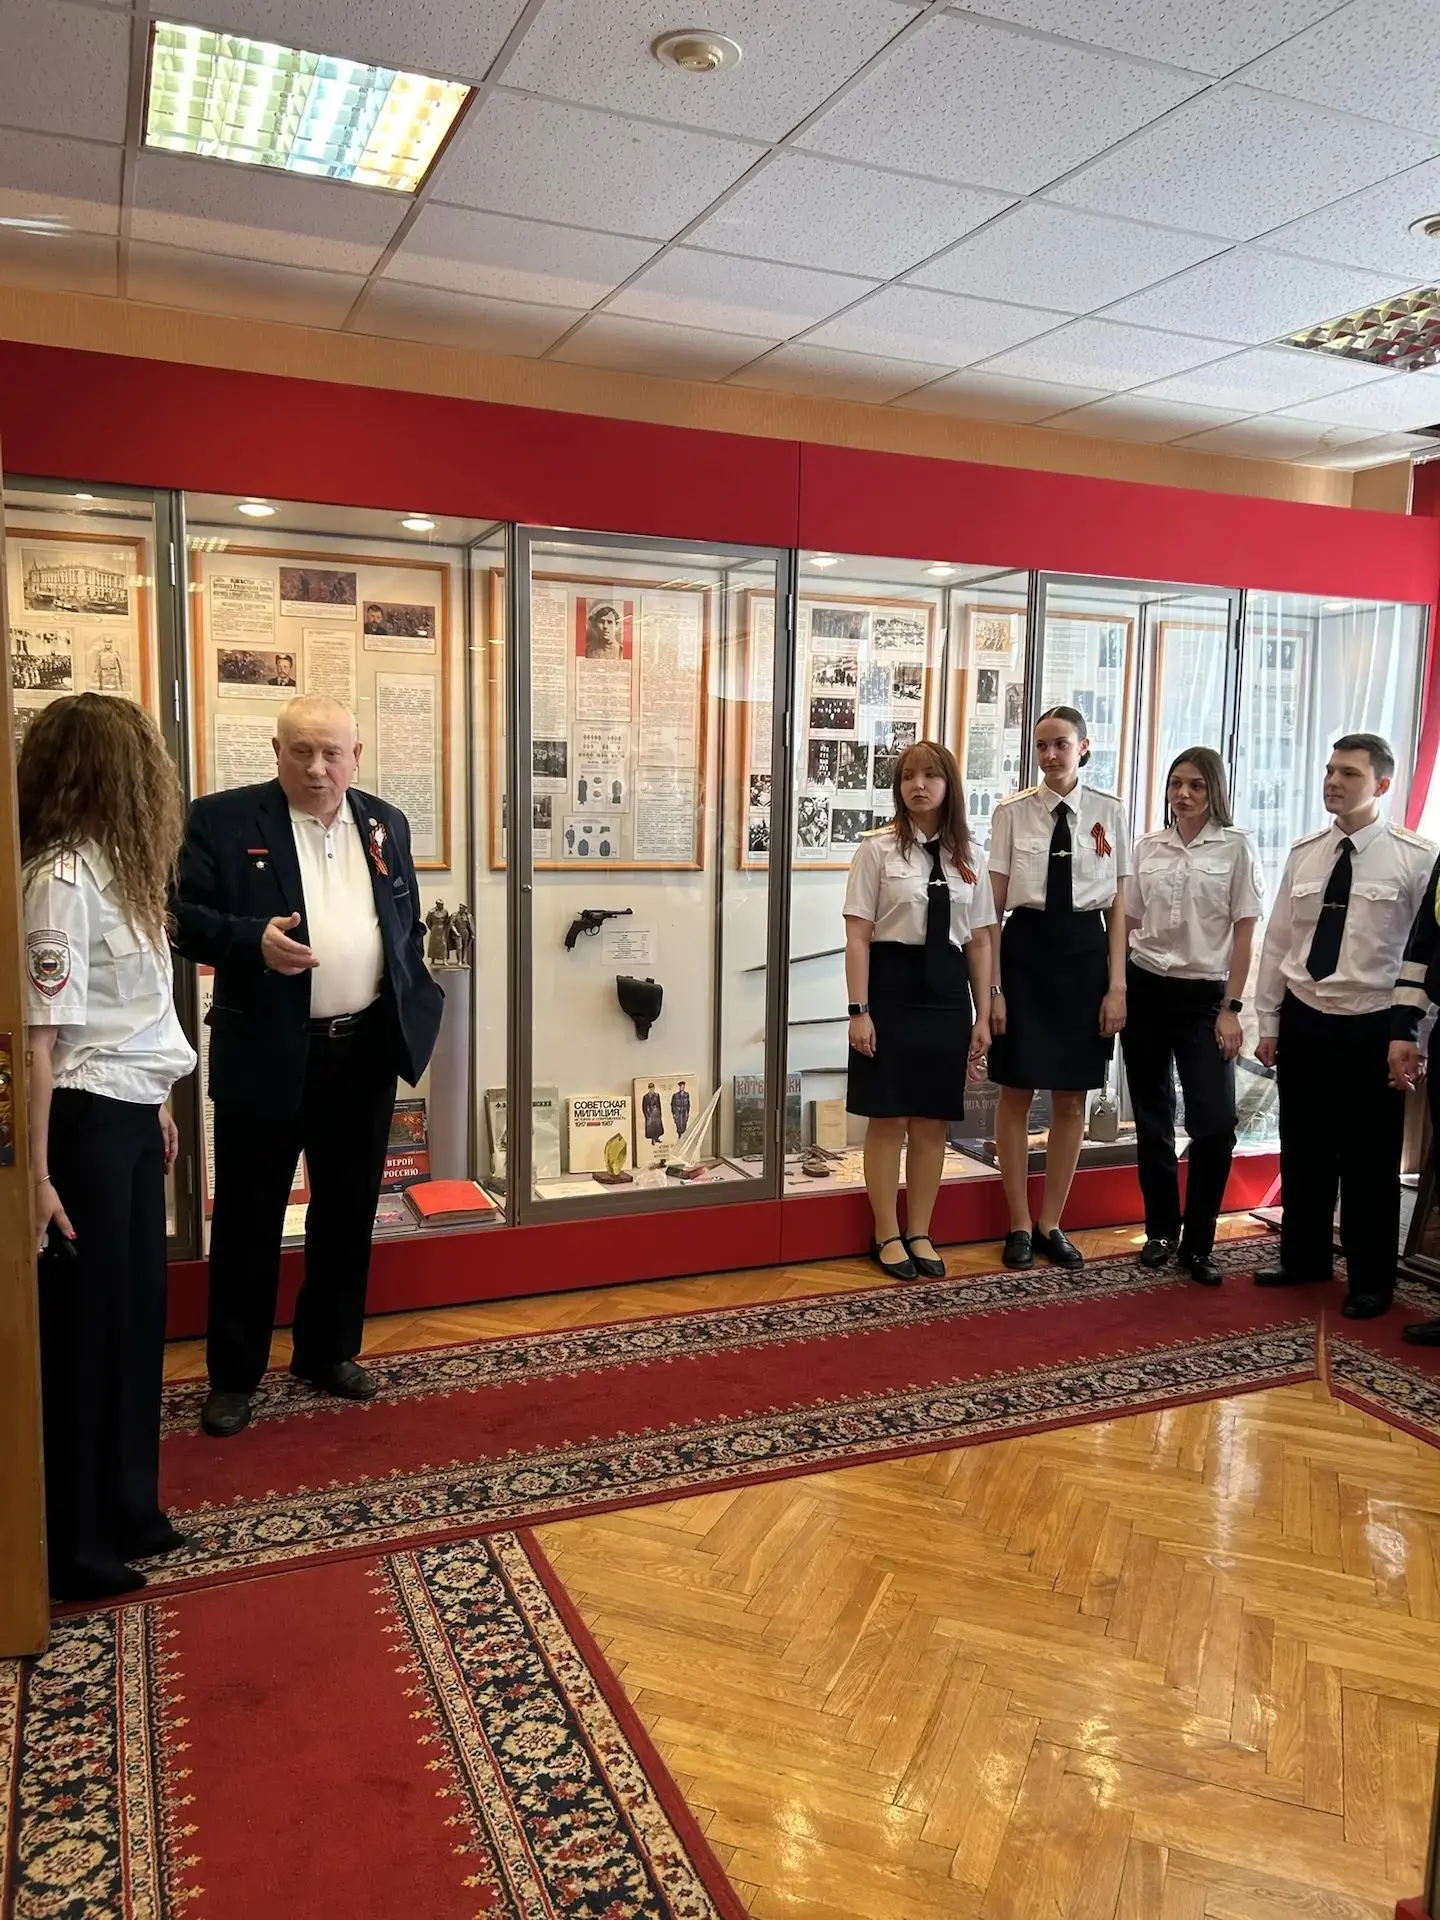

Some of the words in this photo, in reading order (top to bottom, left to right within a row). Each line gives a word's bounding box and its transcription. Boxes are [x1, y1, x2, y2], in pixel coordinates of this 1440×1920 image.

[574, 1100, 626, 1109] СОВЕТСКАЯ
[386, 1156, 414, 1167] ВЕРОЙ
[383, 1168, 419, 1178] РОССИЮ
